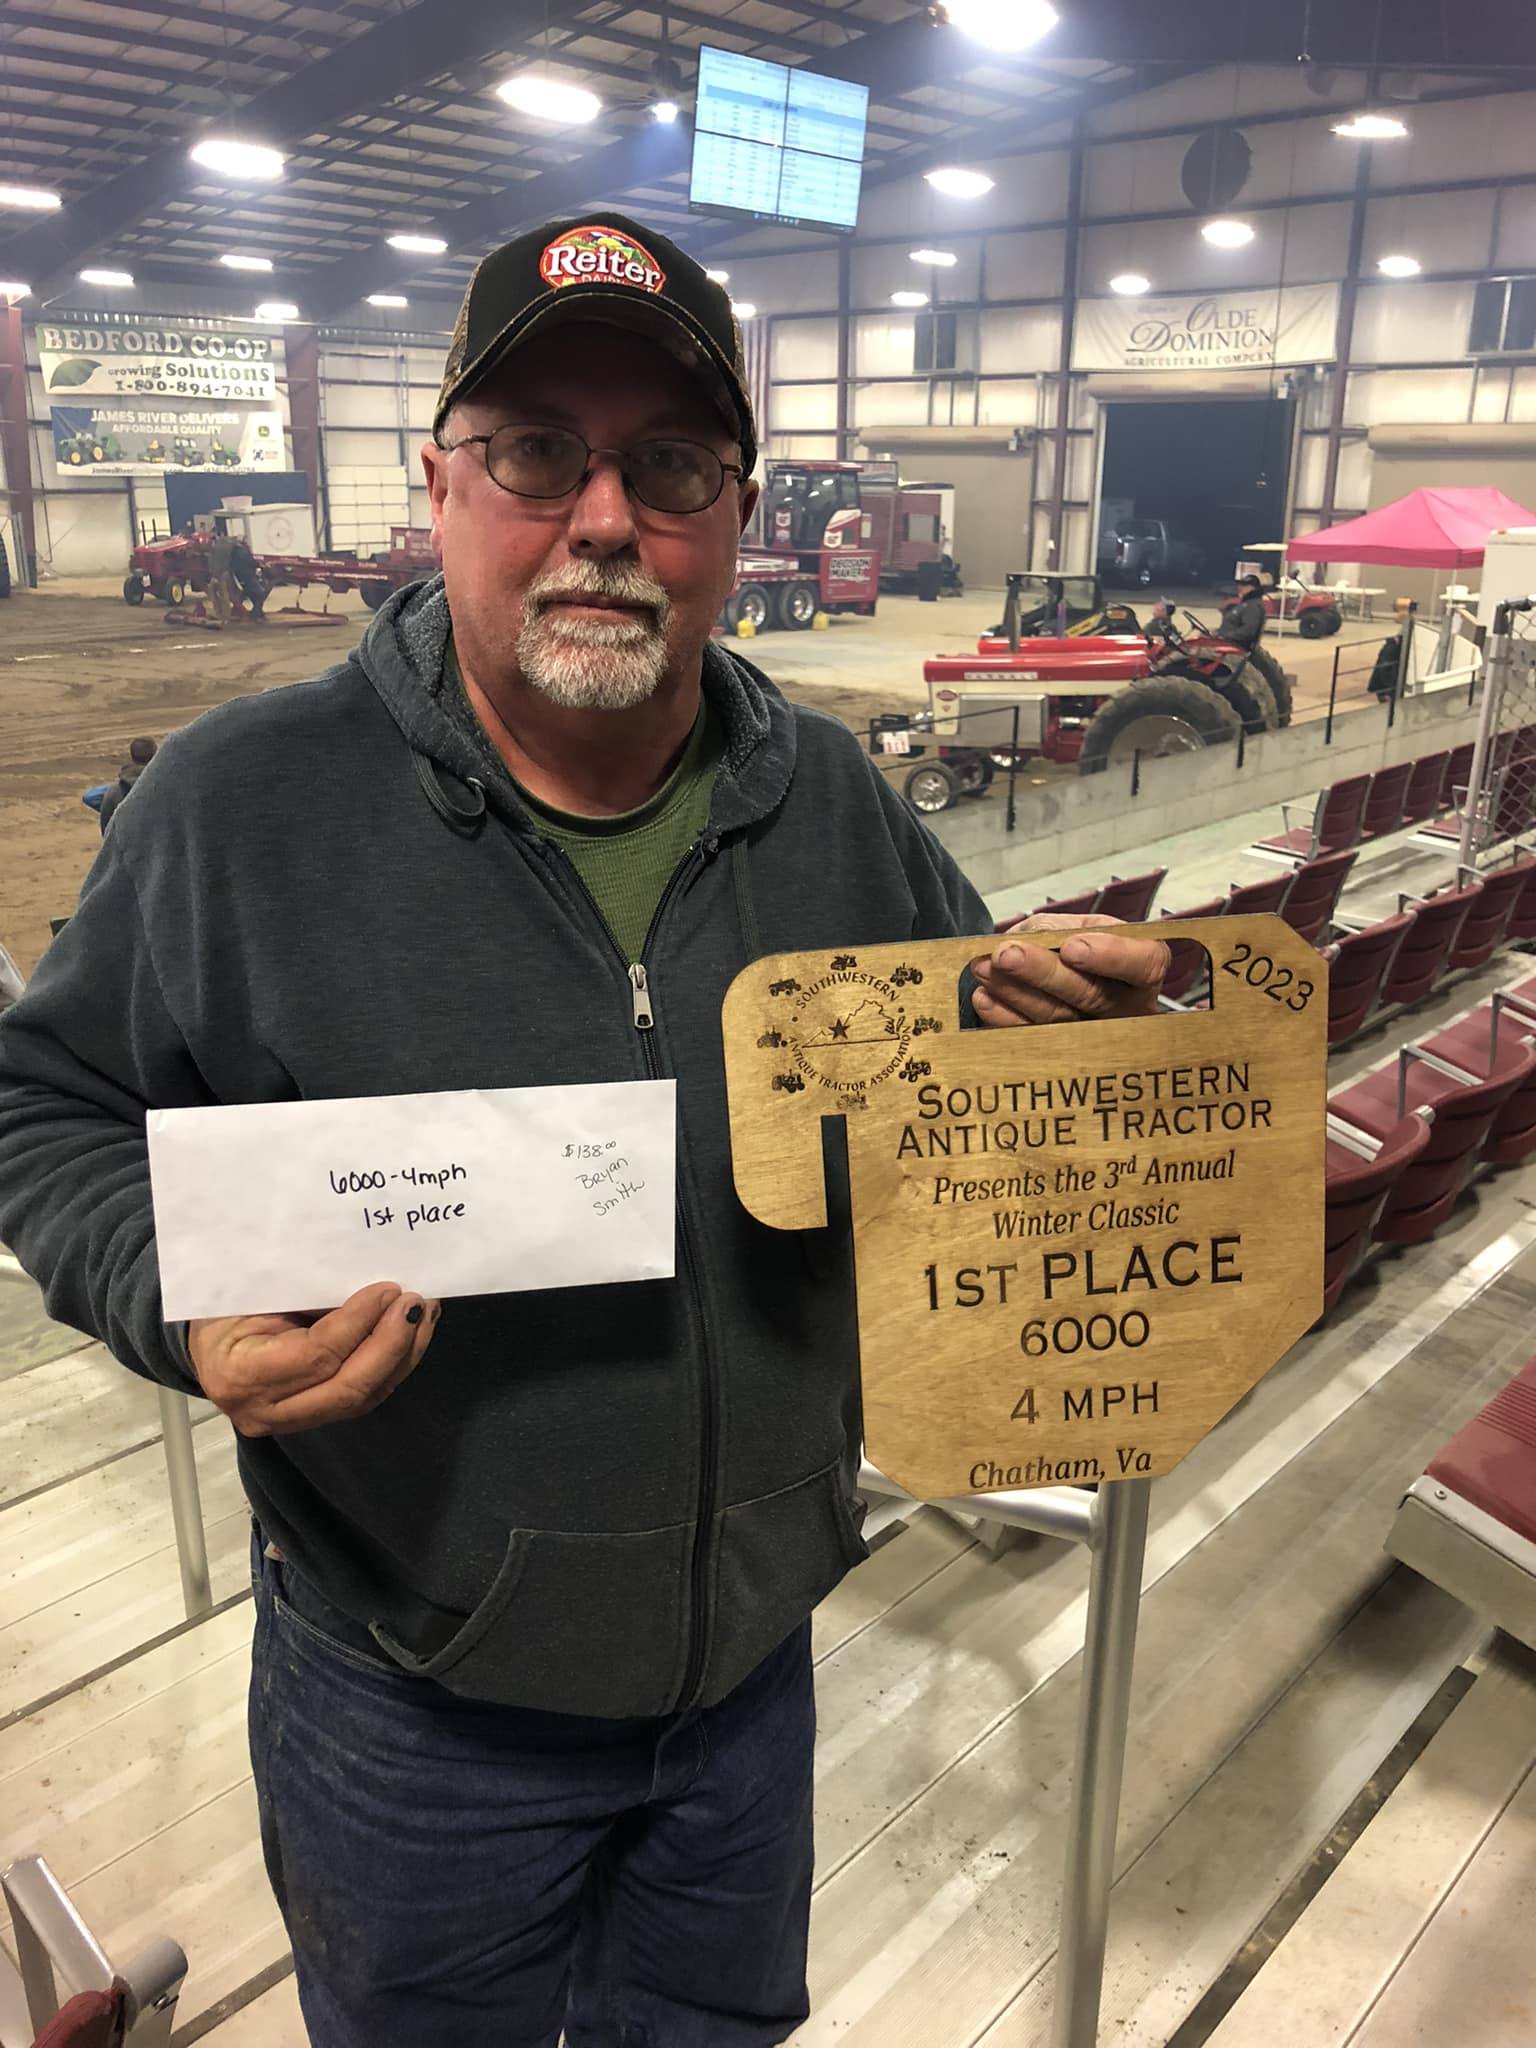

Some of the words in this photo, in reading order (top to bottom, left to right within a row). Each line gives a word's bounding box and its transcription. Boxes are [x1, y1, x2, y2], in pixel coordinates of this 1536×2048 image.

[546, 245, 660, 287] Reiter
[44, 328, 184, 354] BEDFORD
[190, 335, 268, 361] CO-OP
[115, 380, 265, 397] 1-800-894-7041
[166, 362, 270, 382] Solutions
[90, 410, 135, 423] JAMES
[138, 412, 176, 424] RIVER
[112, 424, 178, 434] AFFORDABLE
[180, 425, 222, 435] QUALITY
[796, 971, 899, 1009] SOUTHWESTERN
[1221, 944, 1314, 1011] 2023
[788, 1036, 818, 1080] ANTIQUE
[818, 1074, 867, 1092] TRACTOR
[869, 1025, 911, 1088] ASSOCIATION
[918, 1063, 1250, 1120] SOUTHWESTERN
[897, 1116, 1076, 1160] ANTIQUE
[1093, 1099, 1272, 1142] TRACTOR
[932, 1169, 1046, 1204] Presents
[1054, 1165, 1097, 1194] the
[1104, 1156, 1137, 1189] 3rd
[1144, 1151, 1236, 1185] Annual
[362, 1206, 395, 1228] 1st
[406, 1202, 466, 1231] place
[993, 1208, 1082, 1239] Winter
[1088, 1198, 1180, 1231] Classic
[924, 1262, 1018, 1311] 1ST
[1042, 1235, 1244, 1300] PLACE
[1020, 1311, 1150, 1357] 6000
[1010, 1388, 1040, 1425] 4
[1063, 1381, 1160, 1421] MPH
[969, 1459, 1107, 1489] Chatham,
[1116, 1447, 1153, 1474] Va
